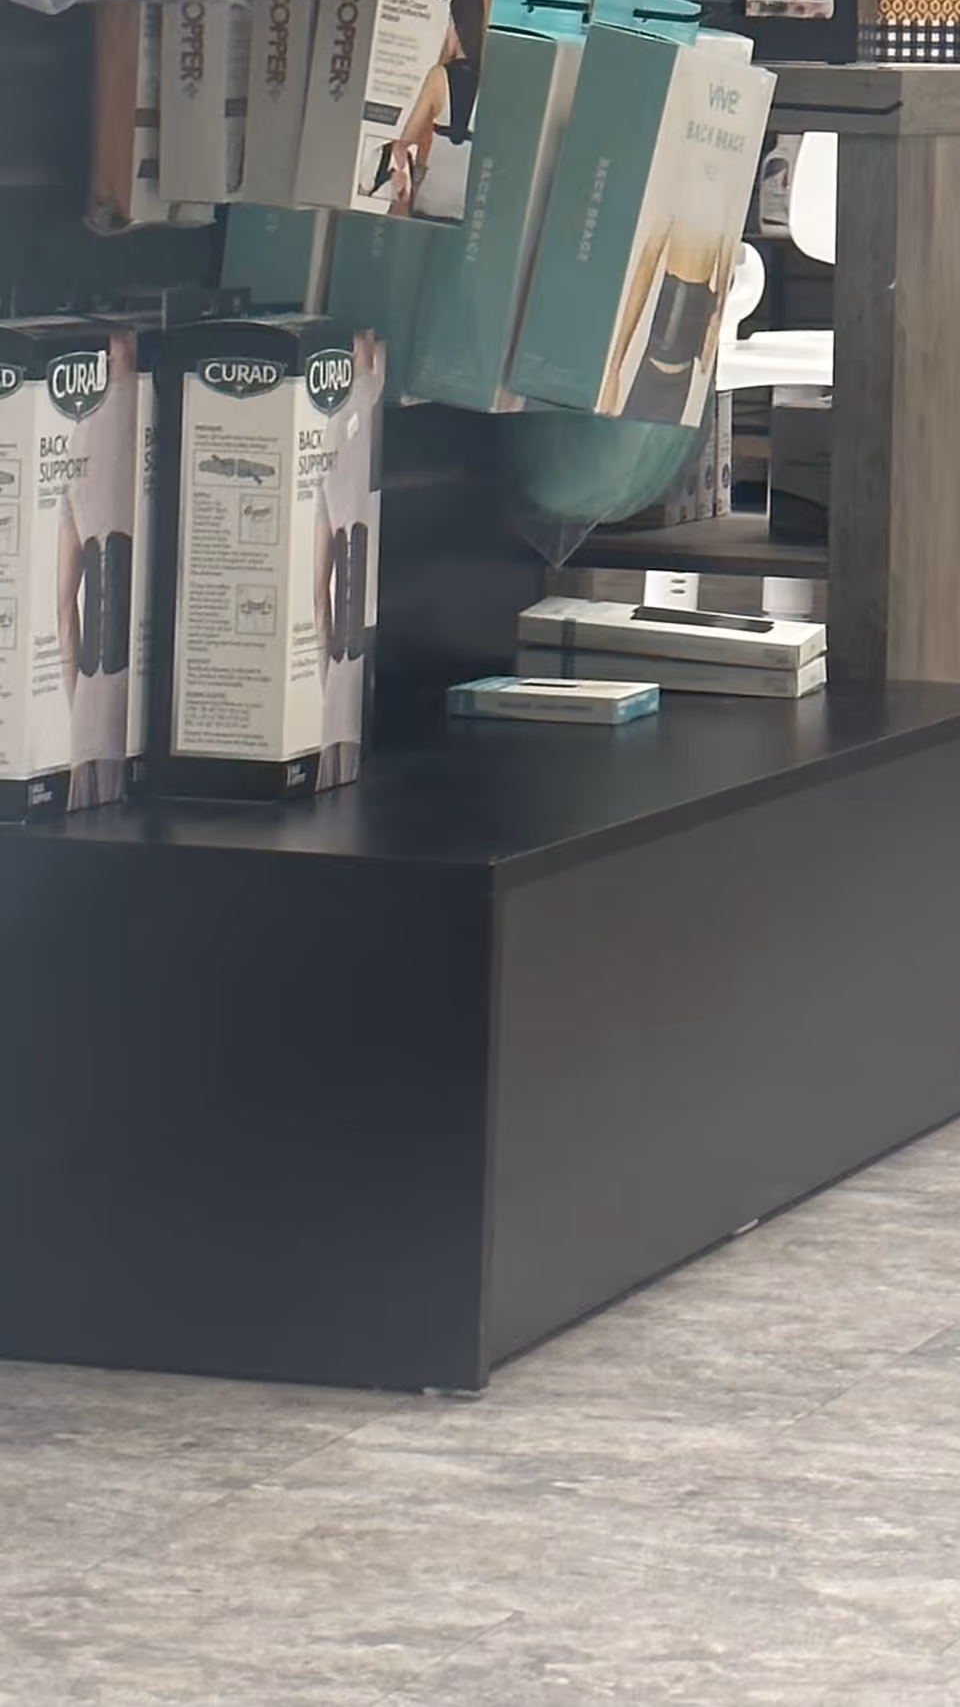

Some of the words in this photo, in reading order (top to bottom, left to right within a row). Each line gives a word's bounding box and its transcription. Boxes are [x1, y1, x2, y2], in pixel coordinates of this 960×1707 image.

[180, 0, 205, 100] OPPER+
[53, 358, 108, 399] CURAD
[204, 362, 277, 385] CURAD
[309, 358, 352, 394] CURAD
[39, 434, 69, 458] BACK
[298, 430, 324, 451] BACK
[38, 457, 90, 483] SUPPORT
[297, 451, 339, 476] SUPPORT
